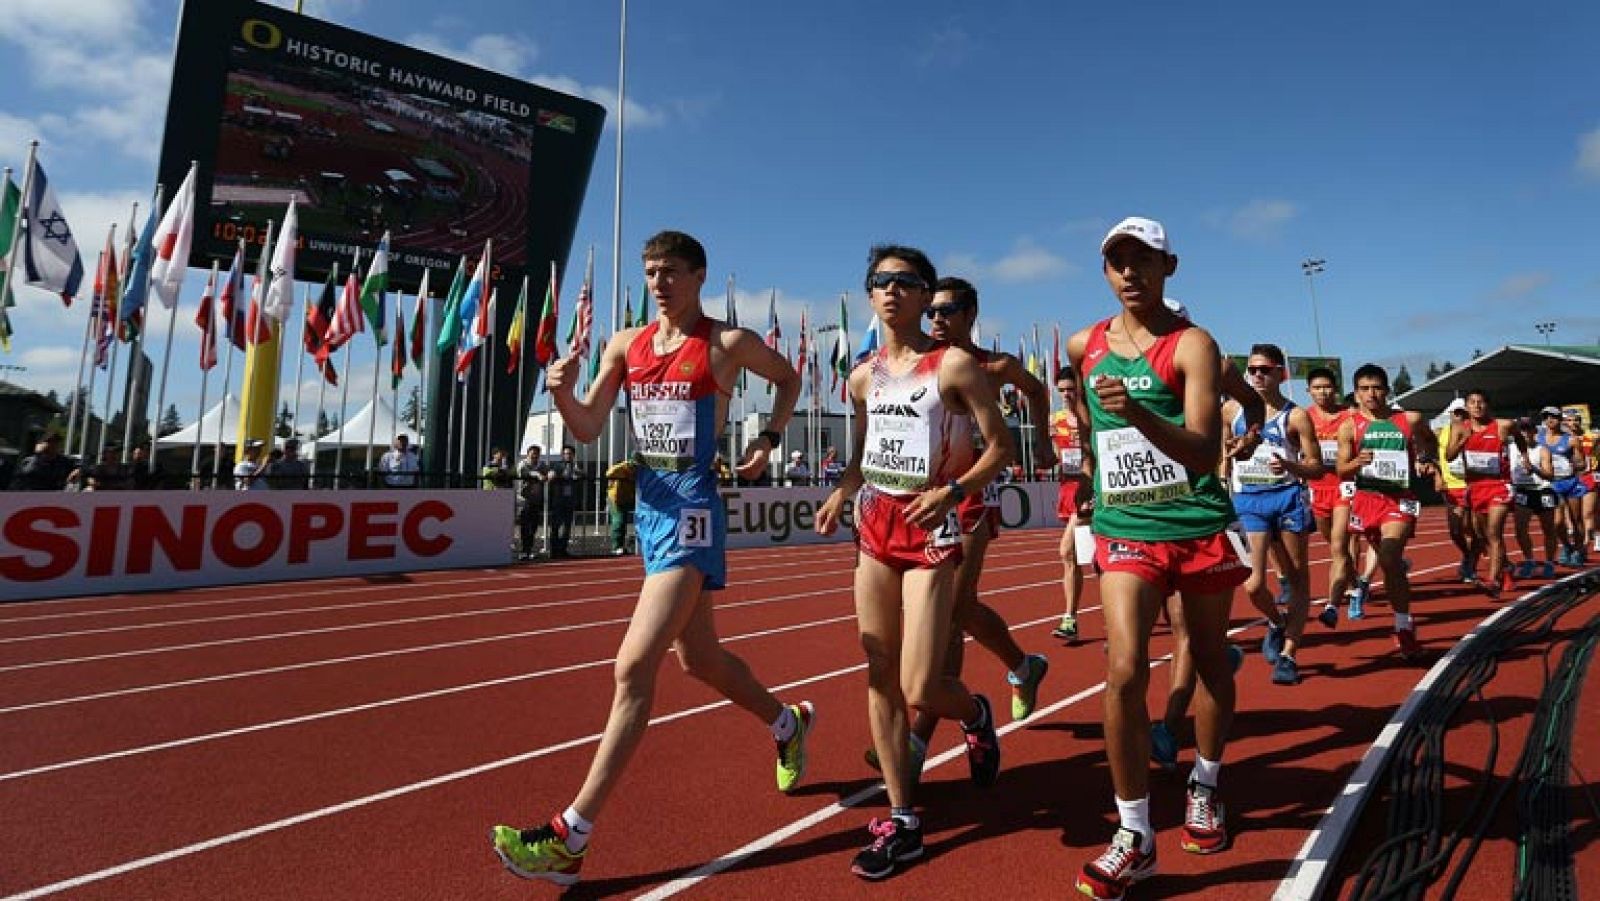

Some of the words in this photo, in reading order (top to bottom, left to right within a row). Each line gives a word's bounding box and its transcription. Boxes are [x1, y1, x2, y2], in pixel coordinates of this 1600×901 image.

[286, 38, 381, 79] HISTORIC
[389, 68, 476, 103] HAYWARD
[483, 92, 530, 118] FIELD
[309, 240, 374, 257] UNIVERIT
[404, 254, 450, 269] OREGON
[631, 382, 693, 400] RUSSIA
[1089, 373, 1152, 390] MICO
[870, 404, 920, 417] JAPAN
[641, 422, 674, 439] 1297
[635, 438, 688, 454] ARKOV
[879, 437, 905, 455] 947
[1115, 450, 1156, 470] 1054
[1108, 464, 1176, 489] DOCTOR
[1107, 491, 1155, 505] OREGON
[723, 492, 854, 543] Eugee
[685, 516, 706, 541] 31
[0, 500, 454, 582] SINOPEC
